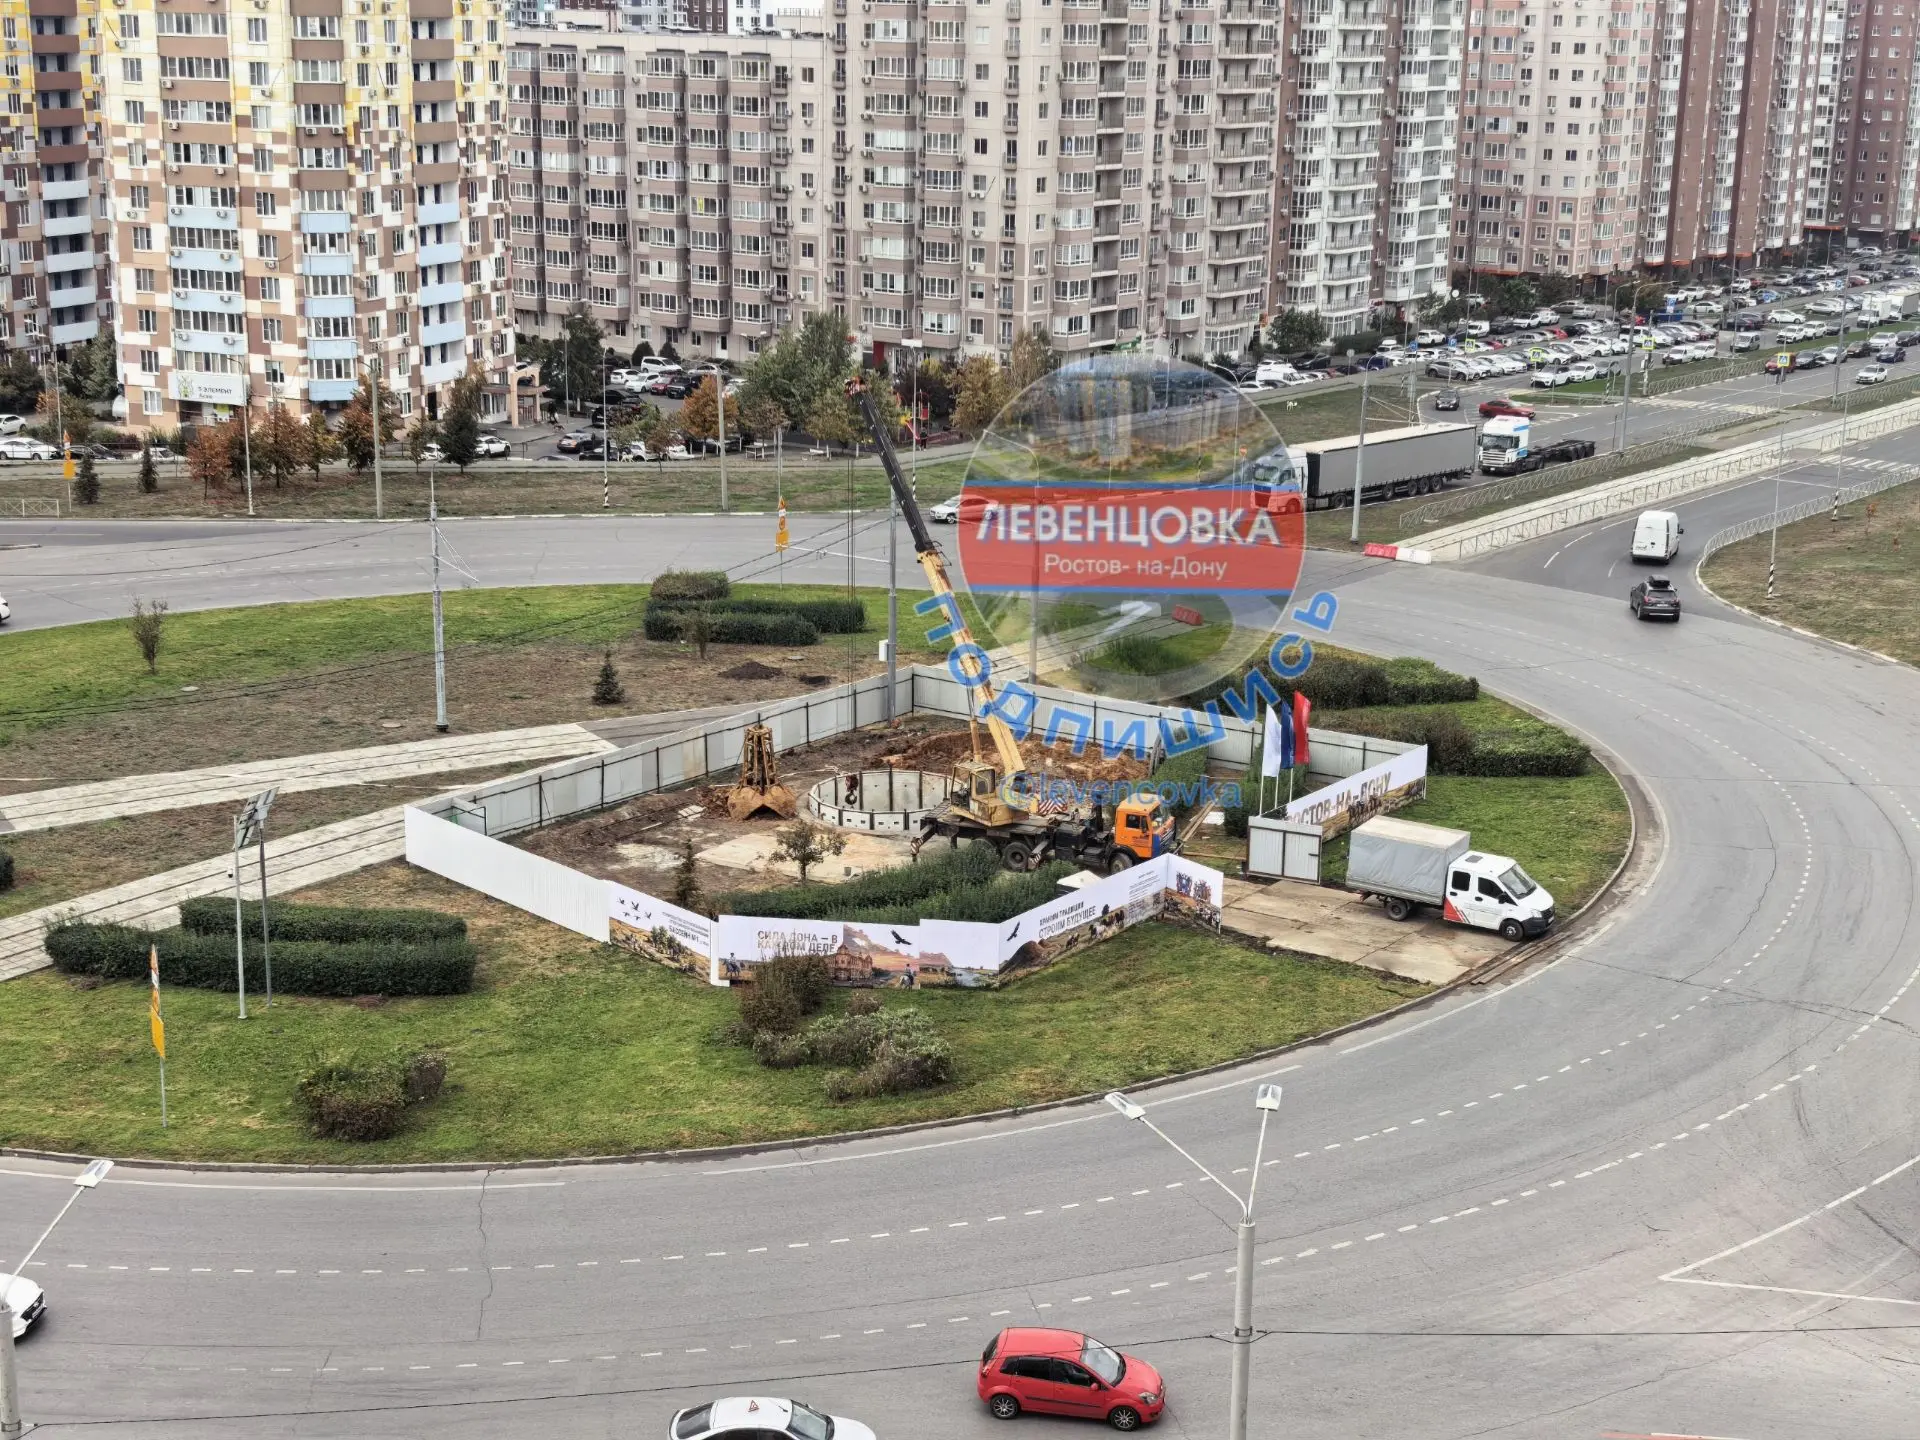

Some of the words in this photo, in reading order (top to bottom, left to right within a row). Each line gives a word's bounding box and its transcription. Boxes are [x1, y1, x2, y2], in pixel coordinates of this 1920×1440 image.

[1039, 919, 1065, 938] СТРОИМ
[1067, 905, 1096, 926] БУДУЩЕЕ
[757, 930, 786, 942] СИЛА
[831, 935, 838, 944] В
[808, 943, 836, 953] ДЕЛЕ
